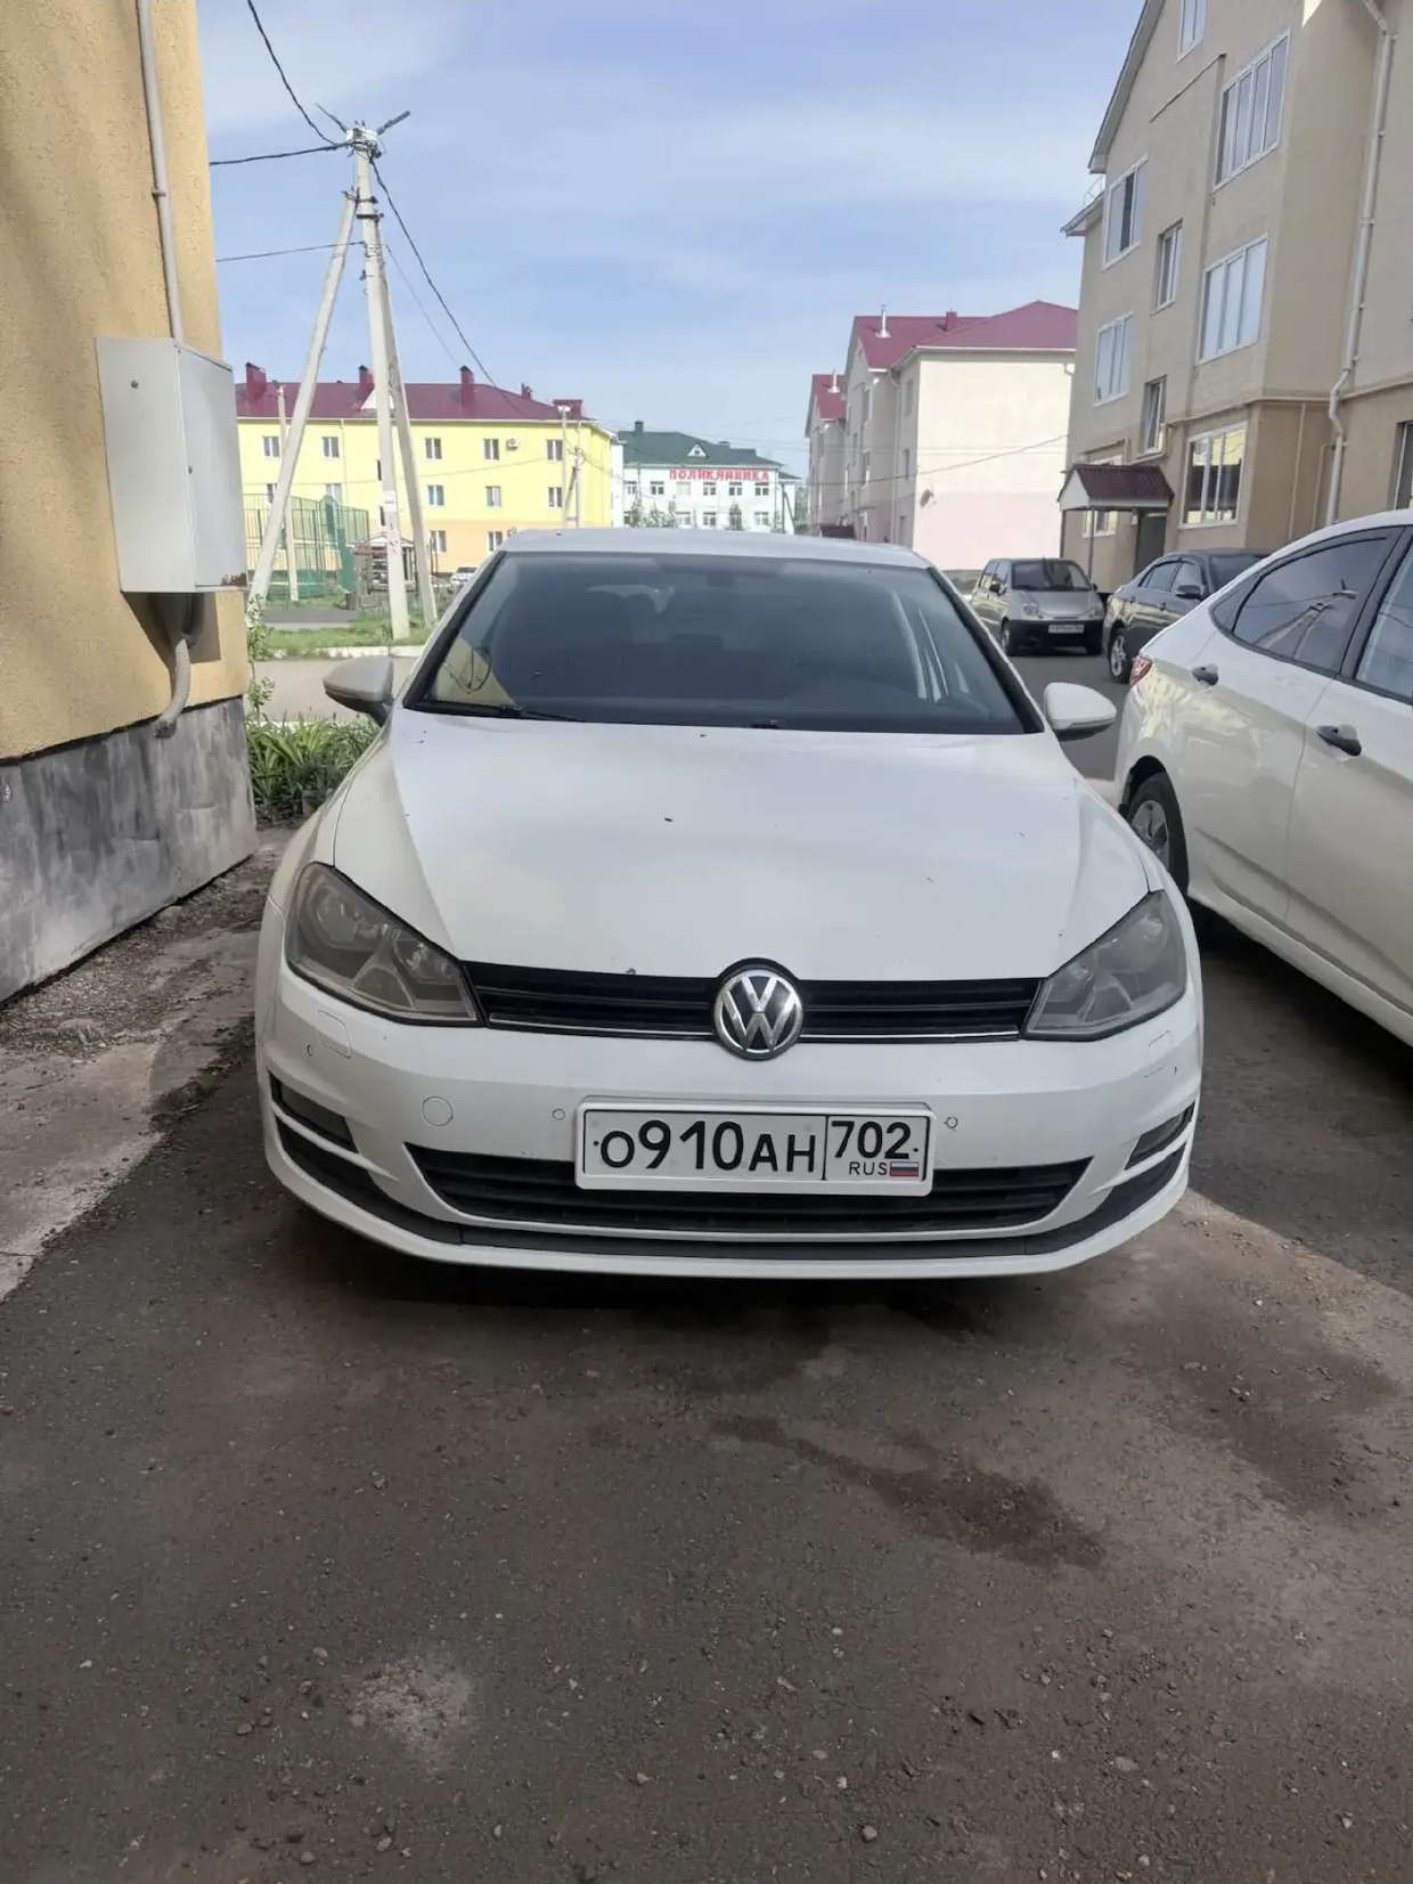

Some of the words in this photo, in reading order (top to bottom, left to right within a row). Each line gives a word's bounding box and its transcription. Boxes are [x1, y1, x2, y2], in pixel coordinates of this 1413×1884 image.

[669, 468, 769, 481] ПОЛИКЛИНИКА
[831, 1120, 911, 1160] 702
[848, 1161, 888, 1176] RUS
